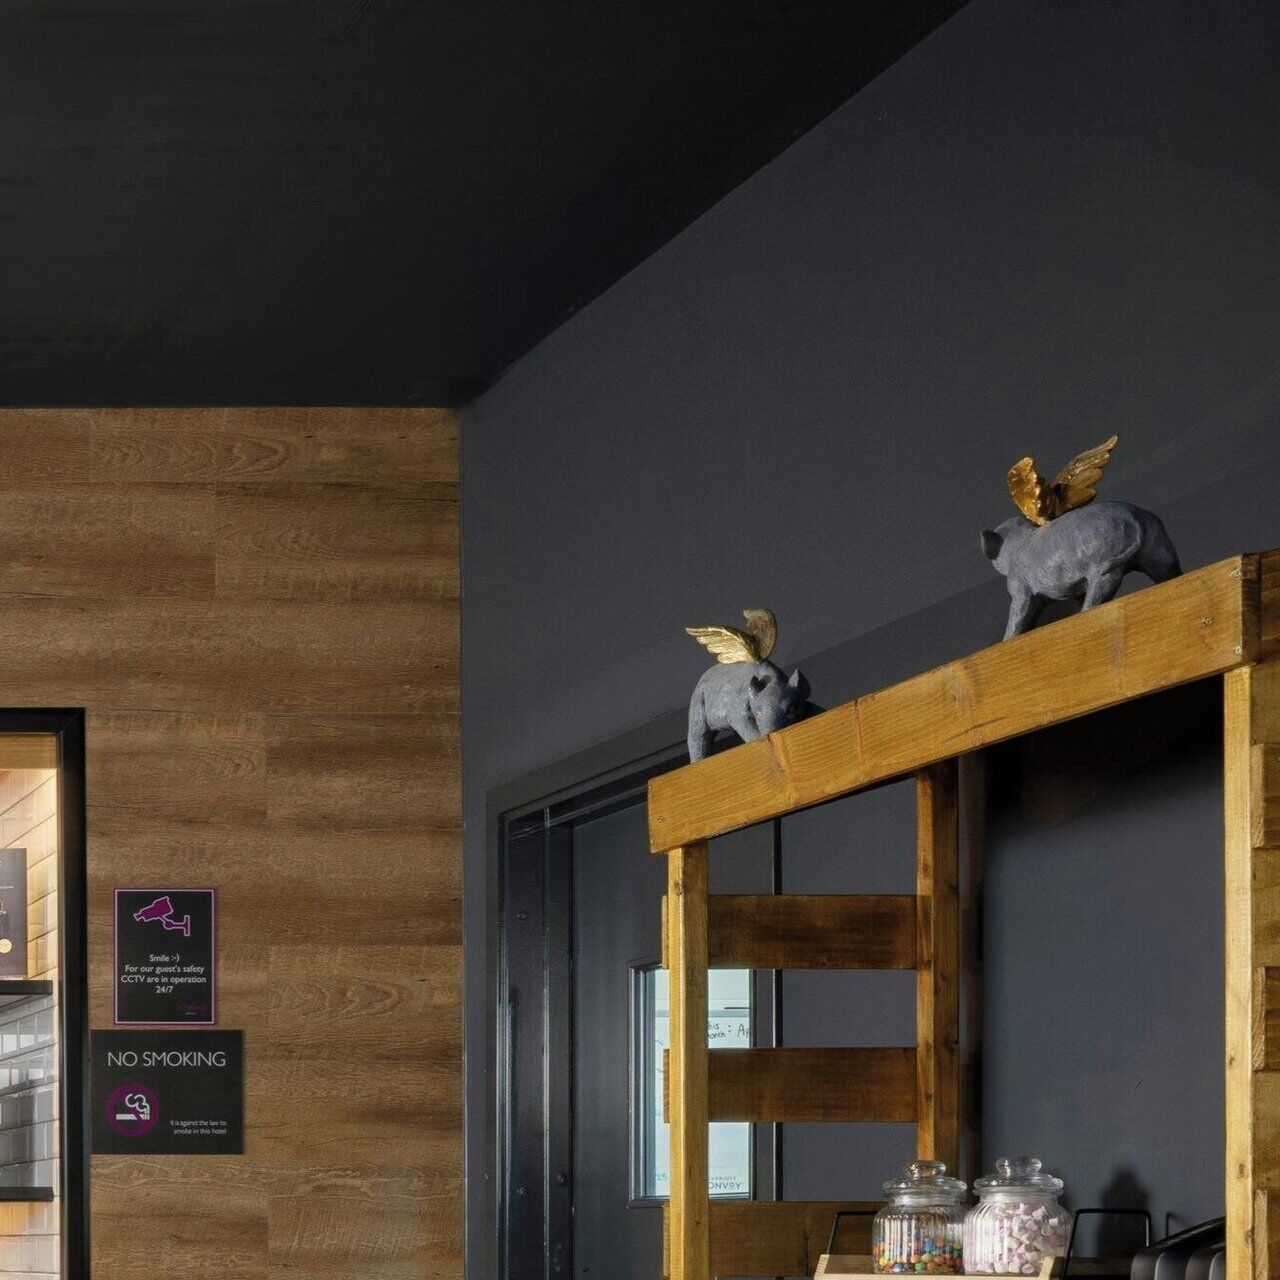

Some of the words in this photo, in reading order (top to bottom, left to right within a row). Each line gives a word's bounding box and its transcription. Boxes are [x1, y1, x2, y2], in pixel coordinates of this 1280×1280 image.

[149, 954, 170, 962] Smile
[125, 964, 139, 972] For
[155, 965, 181, 974] guest's
[183, 964, 205, 975] safety
[120, 975, 145, 983] CCTV
[161, 975, 169, 983] in
[170, 976, 207, 984] operation
[155, 985, 173, 993] 24/7
[107, 1051, 138, 1067] NO
[142, 1051, 226, 1067] SMOKING
